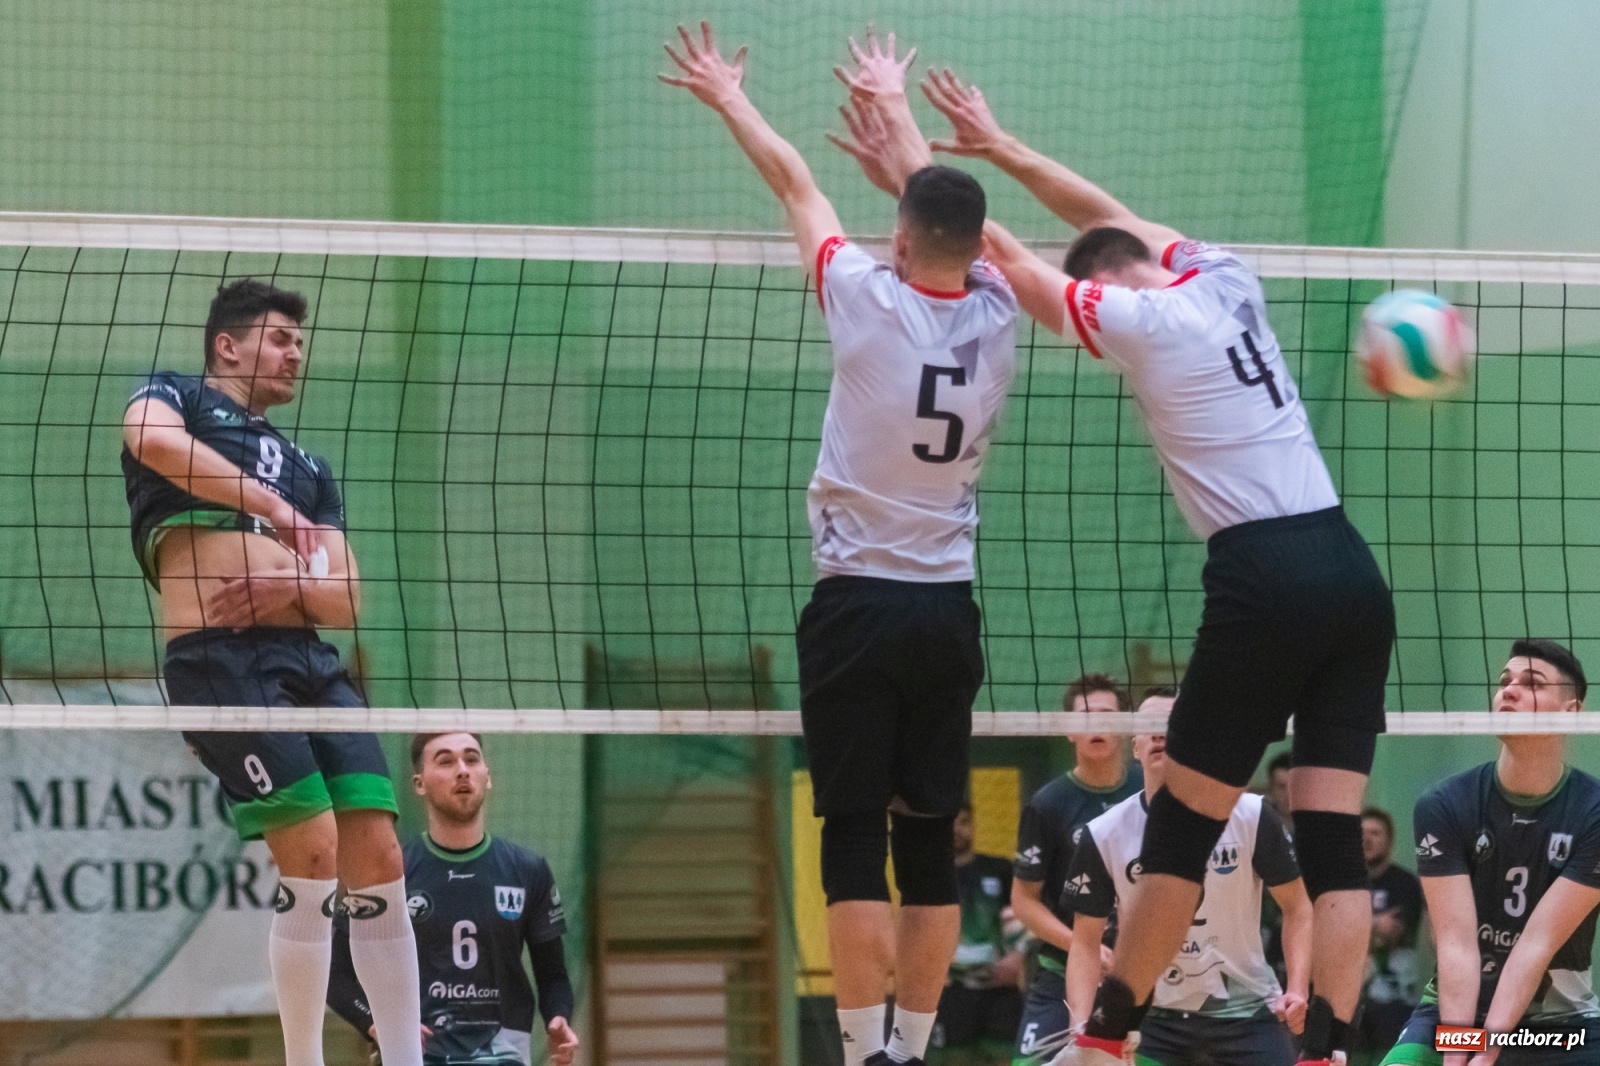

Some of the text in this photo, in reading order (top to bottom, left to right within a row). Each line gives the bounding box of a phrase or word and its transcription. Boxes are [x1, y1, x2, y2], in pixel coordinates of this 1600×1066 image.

[1226, 329, 1285, 409] 4
[912, 363, 966, 464] 5
[257, 435, 283, 482] 9
[244, 754, 273, 795] 9
[1504, 866, 1529, 917] 3
[452, 919, 479, 970] 6
[1180, 940, 1200, 953] GA
[1020, 1022, 1039, 1055] 5
